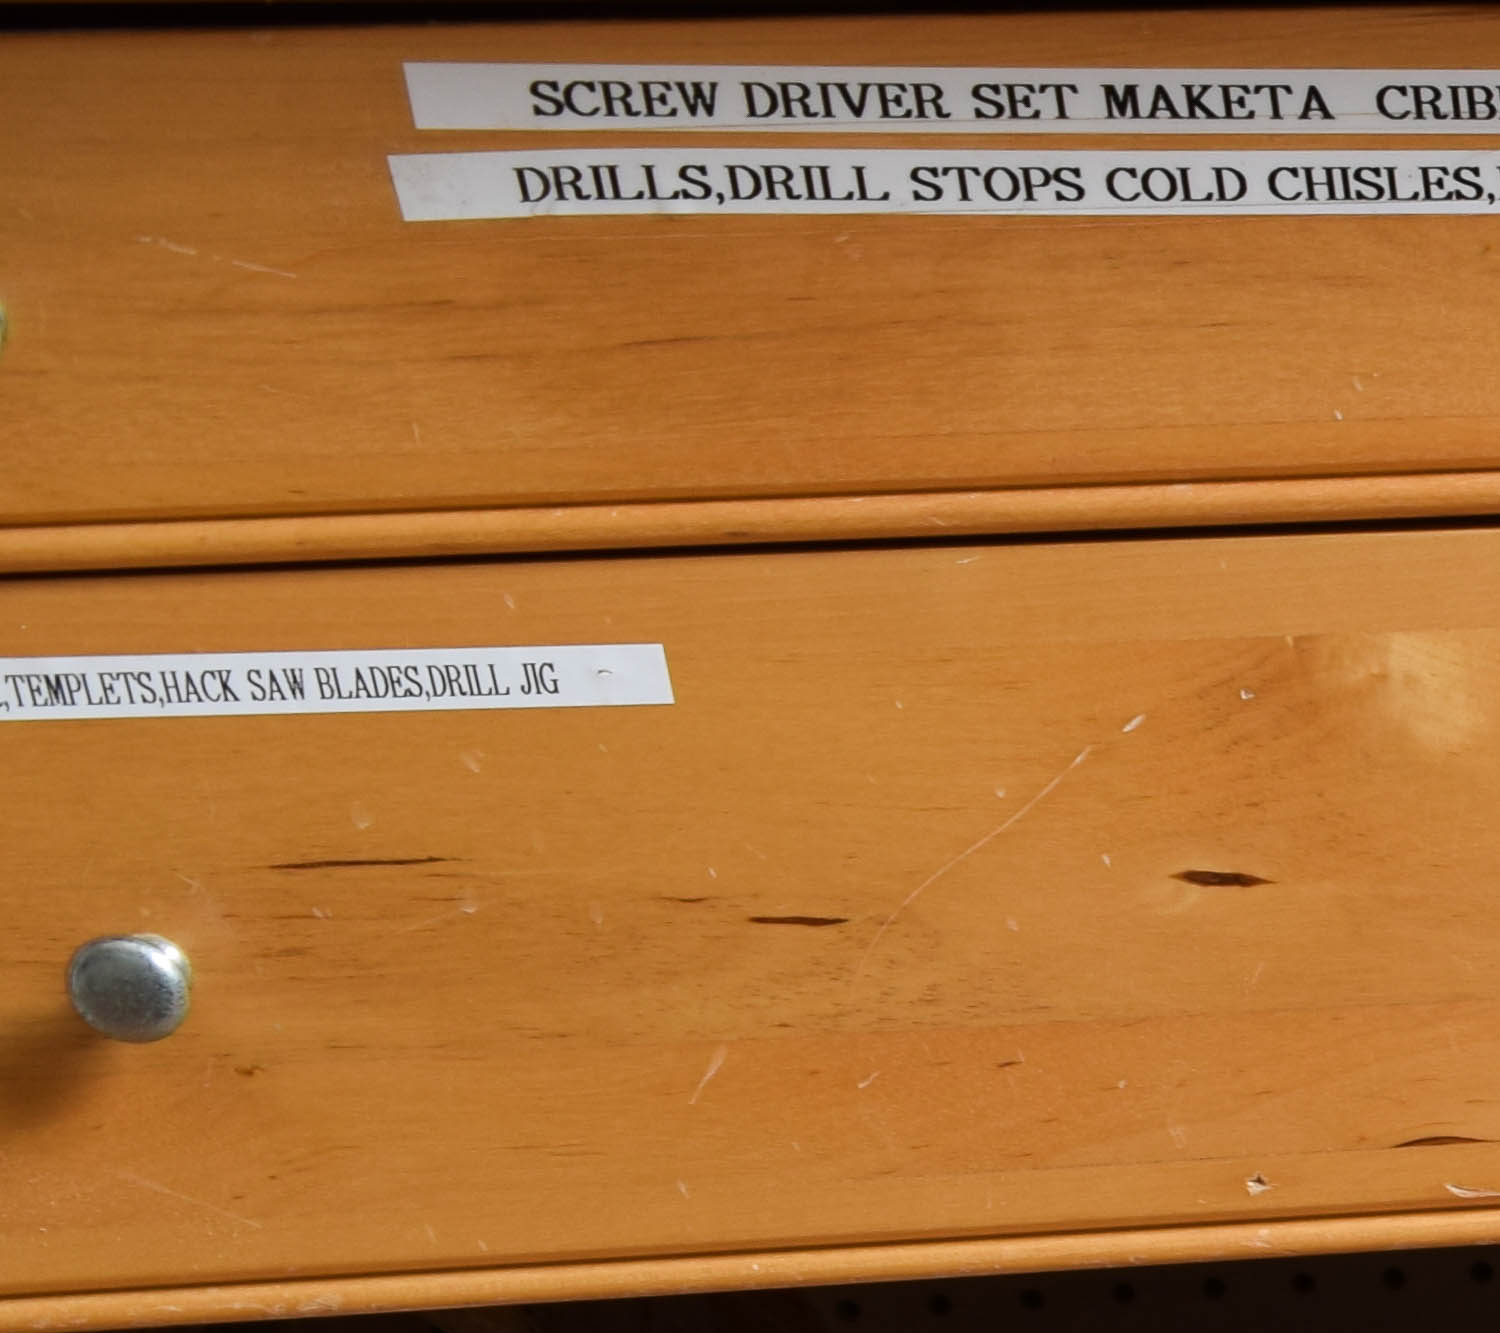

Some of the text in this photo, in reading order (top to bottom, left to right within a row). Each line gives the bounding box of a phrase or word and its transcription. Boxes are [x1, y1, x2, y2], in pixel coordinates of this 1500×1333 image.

[529, 80, 718, 117] SCREW
[740, 82, 951, 119] DRIVER
[971, 84, 1078, 119] SET
[1100, 84, 1335, 120] MAKETA
[514, 165, 890, 205] DRILLS,DRILL
[910, 167, 1085, 201] STOPS
[1106, 167, 1247, 201] COLD
[0, 662, 559, 711] ,TEMPLETS,HACK SAW BLADES,DRILL JIG
